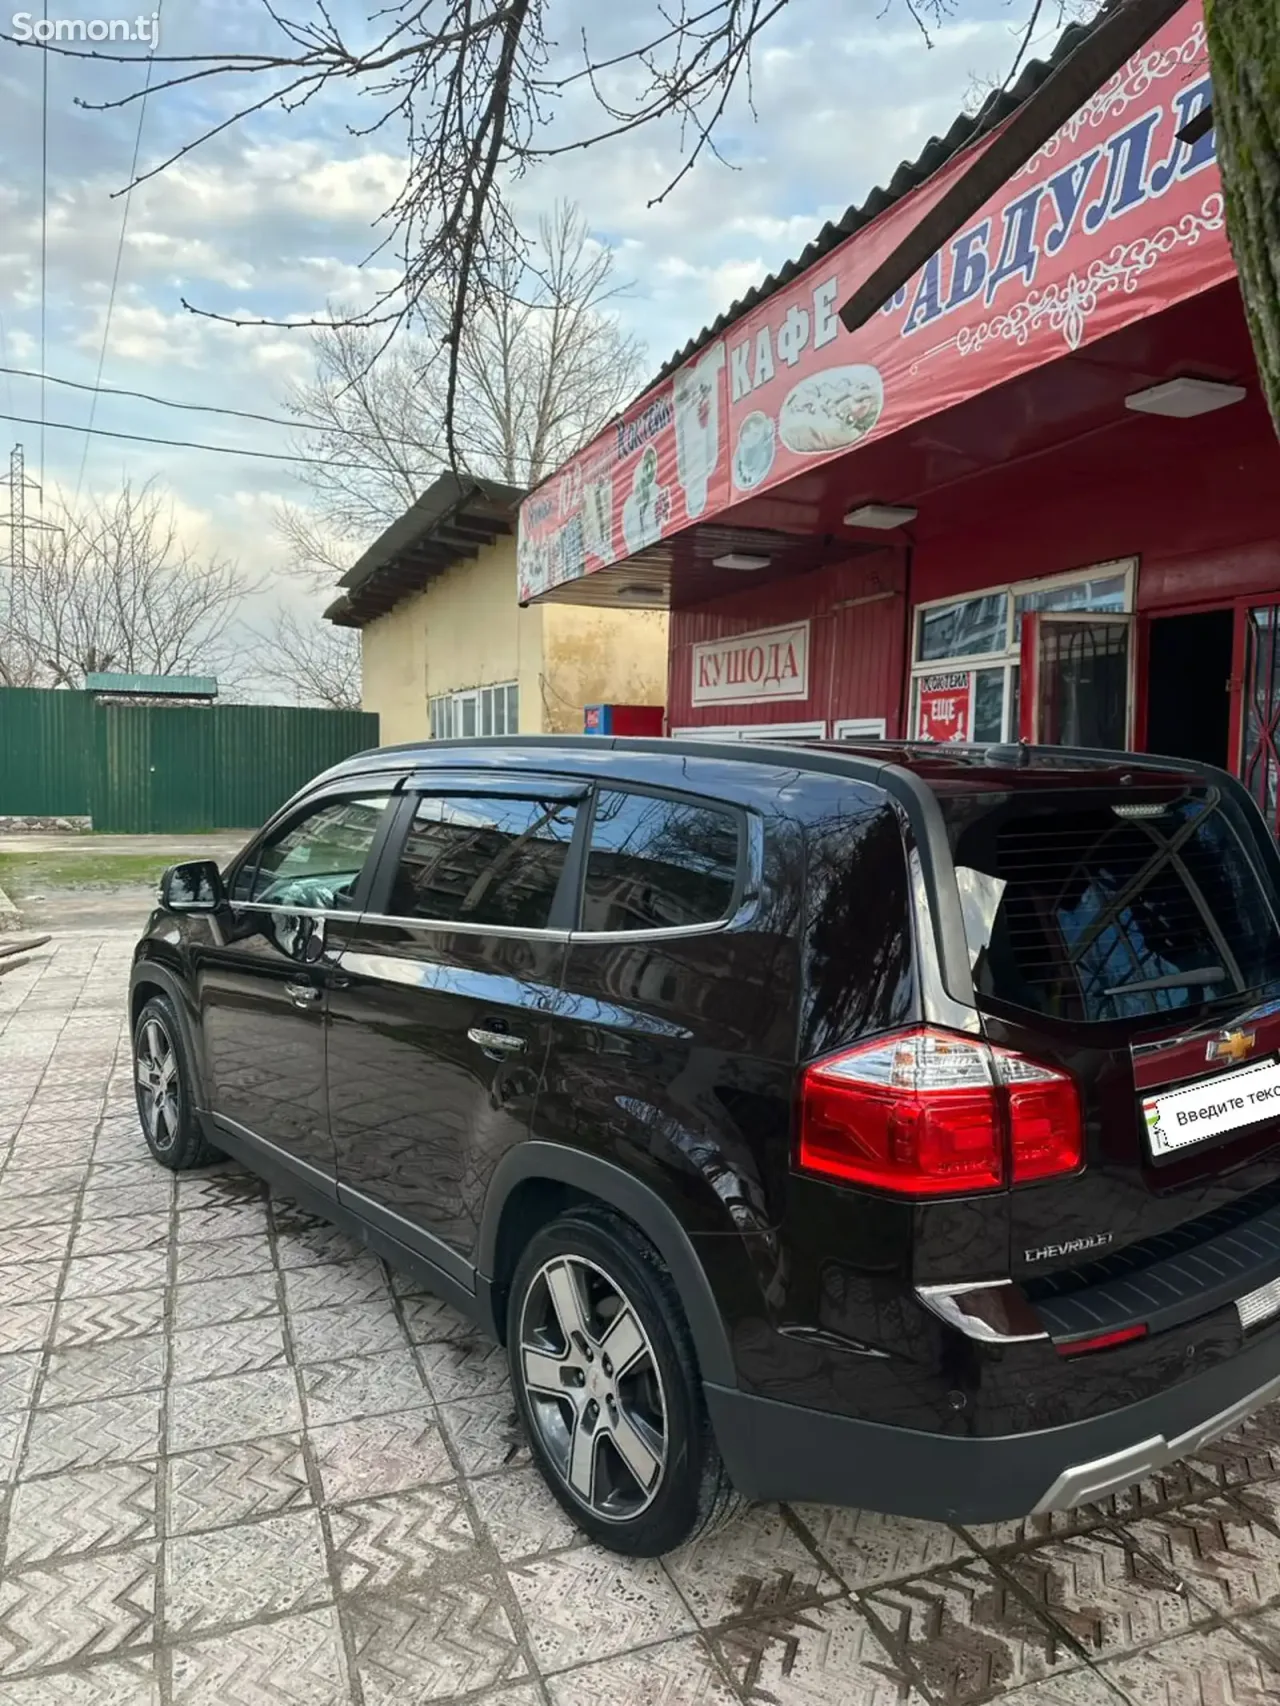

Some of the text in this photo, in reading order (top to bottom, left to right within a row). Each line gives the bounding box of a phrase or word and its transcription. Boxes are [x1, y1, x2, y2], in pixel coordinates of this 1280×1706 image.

[731, 275, 839, 404] КАФЕ
[698, 641, 799, 688] КУШОДА
[1024, 1231, 1114, 1262] CHEVROLET
